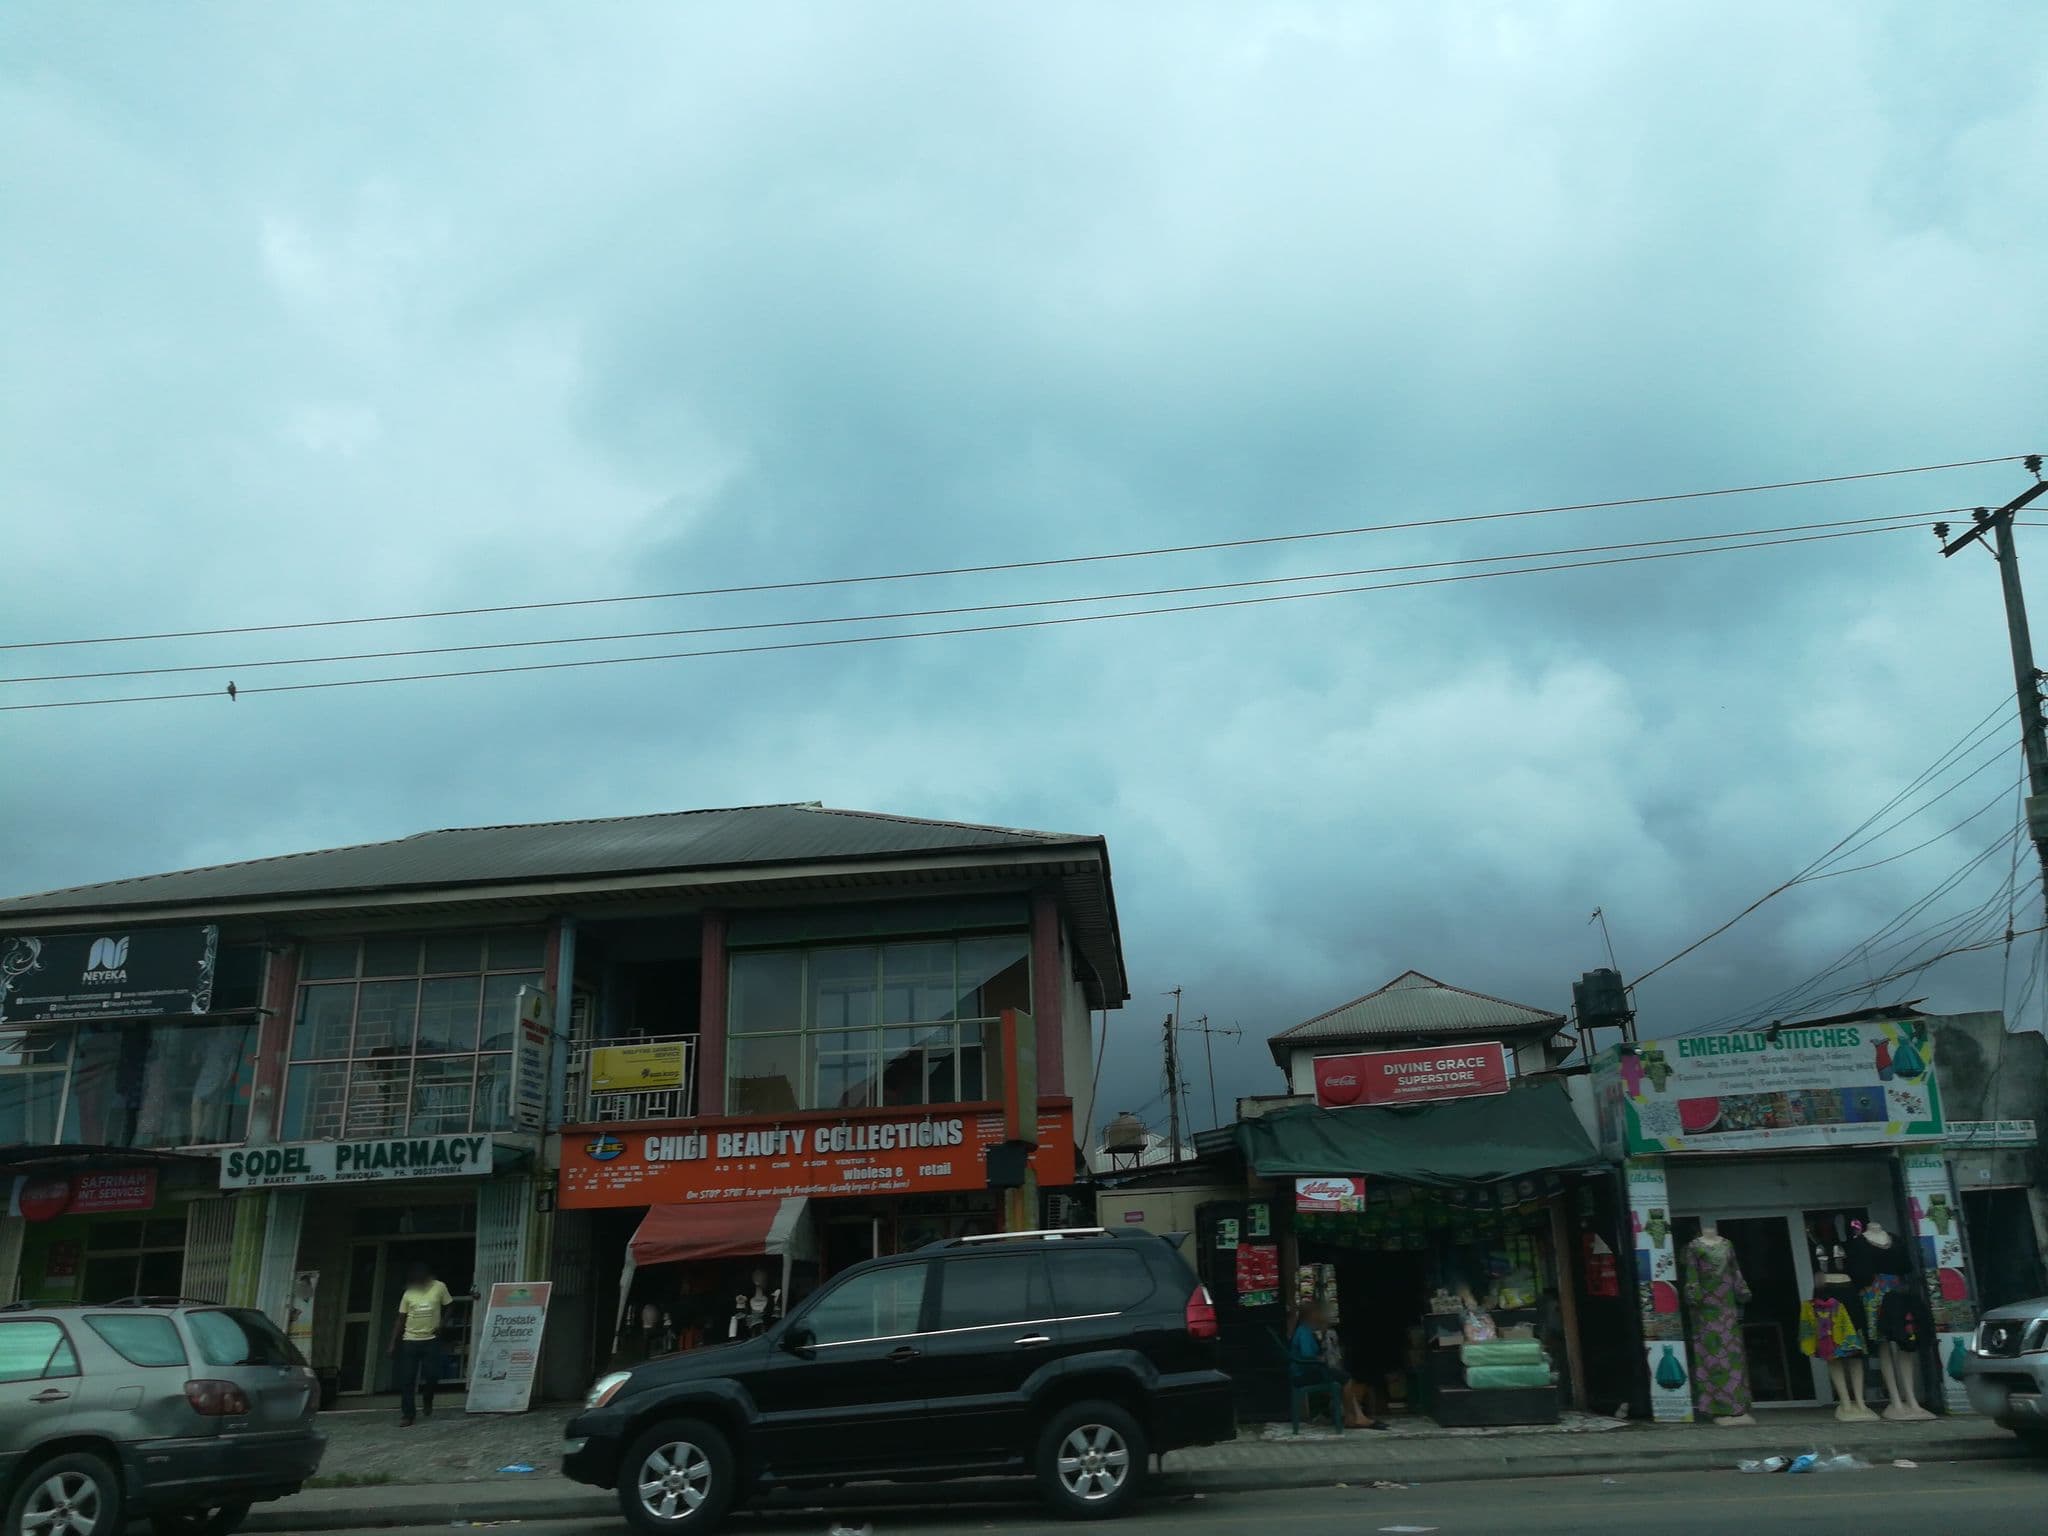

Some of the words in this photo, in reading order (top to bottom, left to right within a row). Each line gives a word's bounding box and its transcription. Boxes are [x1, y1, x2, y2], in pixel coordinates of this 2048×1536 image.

[83, 970, 127, 981] NEYEKA
[1678, 1032, 1767, 1058] EMERALD
[1773, 1027, 1861, 1050] STITCHES
[1383, 1061, 1433, 1076] DIVINE
[1436, 1056, 1486, 1071] GRACE
[1397, 1071, 1474, 1087] SUPERSTORE
[717, 1129, 805, 1158] BEAUTY
[814, 1119, 964, 1154] COLLECTIONS
[227, 1148, 311, 1178] SODEL
[336, 1137, 485, 1171] PHARMACY
[919, 1161, 952, 1177] retail
[80, 1175, 146, 1189] SAFRINAM
[263, 1176, 296, 1184] MARKET
[98, 1187, 145, 1199] SERVICES
[495, 1315, 536, 1325] Prostate
[492, 1326, 533, 1338] Defence
